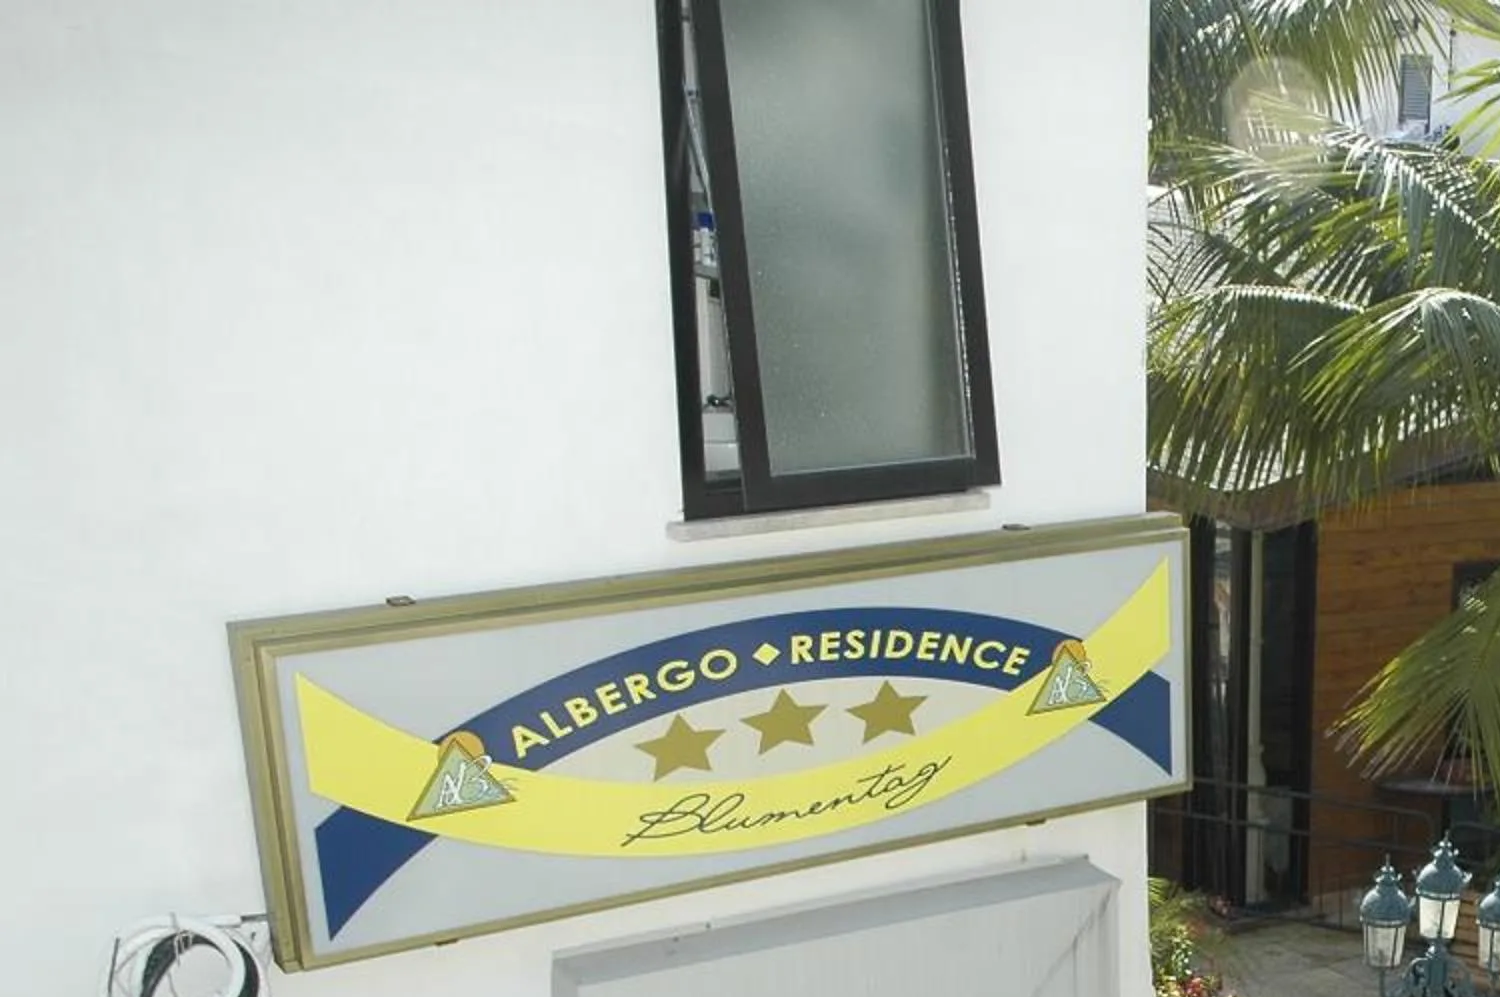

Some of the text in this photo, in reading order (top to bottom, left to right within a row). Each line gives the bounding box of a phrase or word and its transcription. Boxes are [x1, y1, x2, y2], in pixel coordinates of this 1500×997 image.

[511, 629, 1030, 758] ALBERGO RESIDENCE
[621, 755, 952, 847] Blumentag
